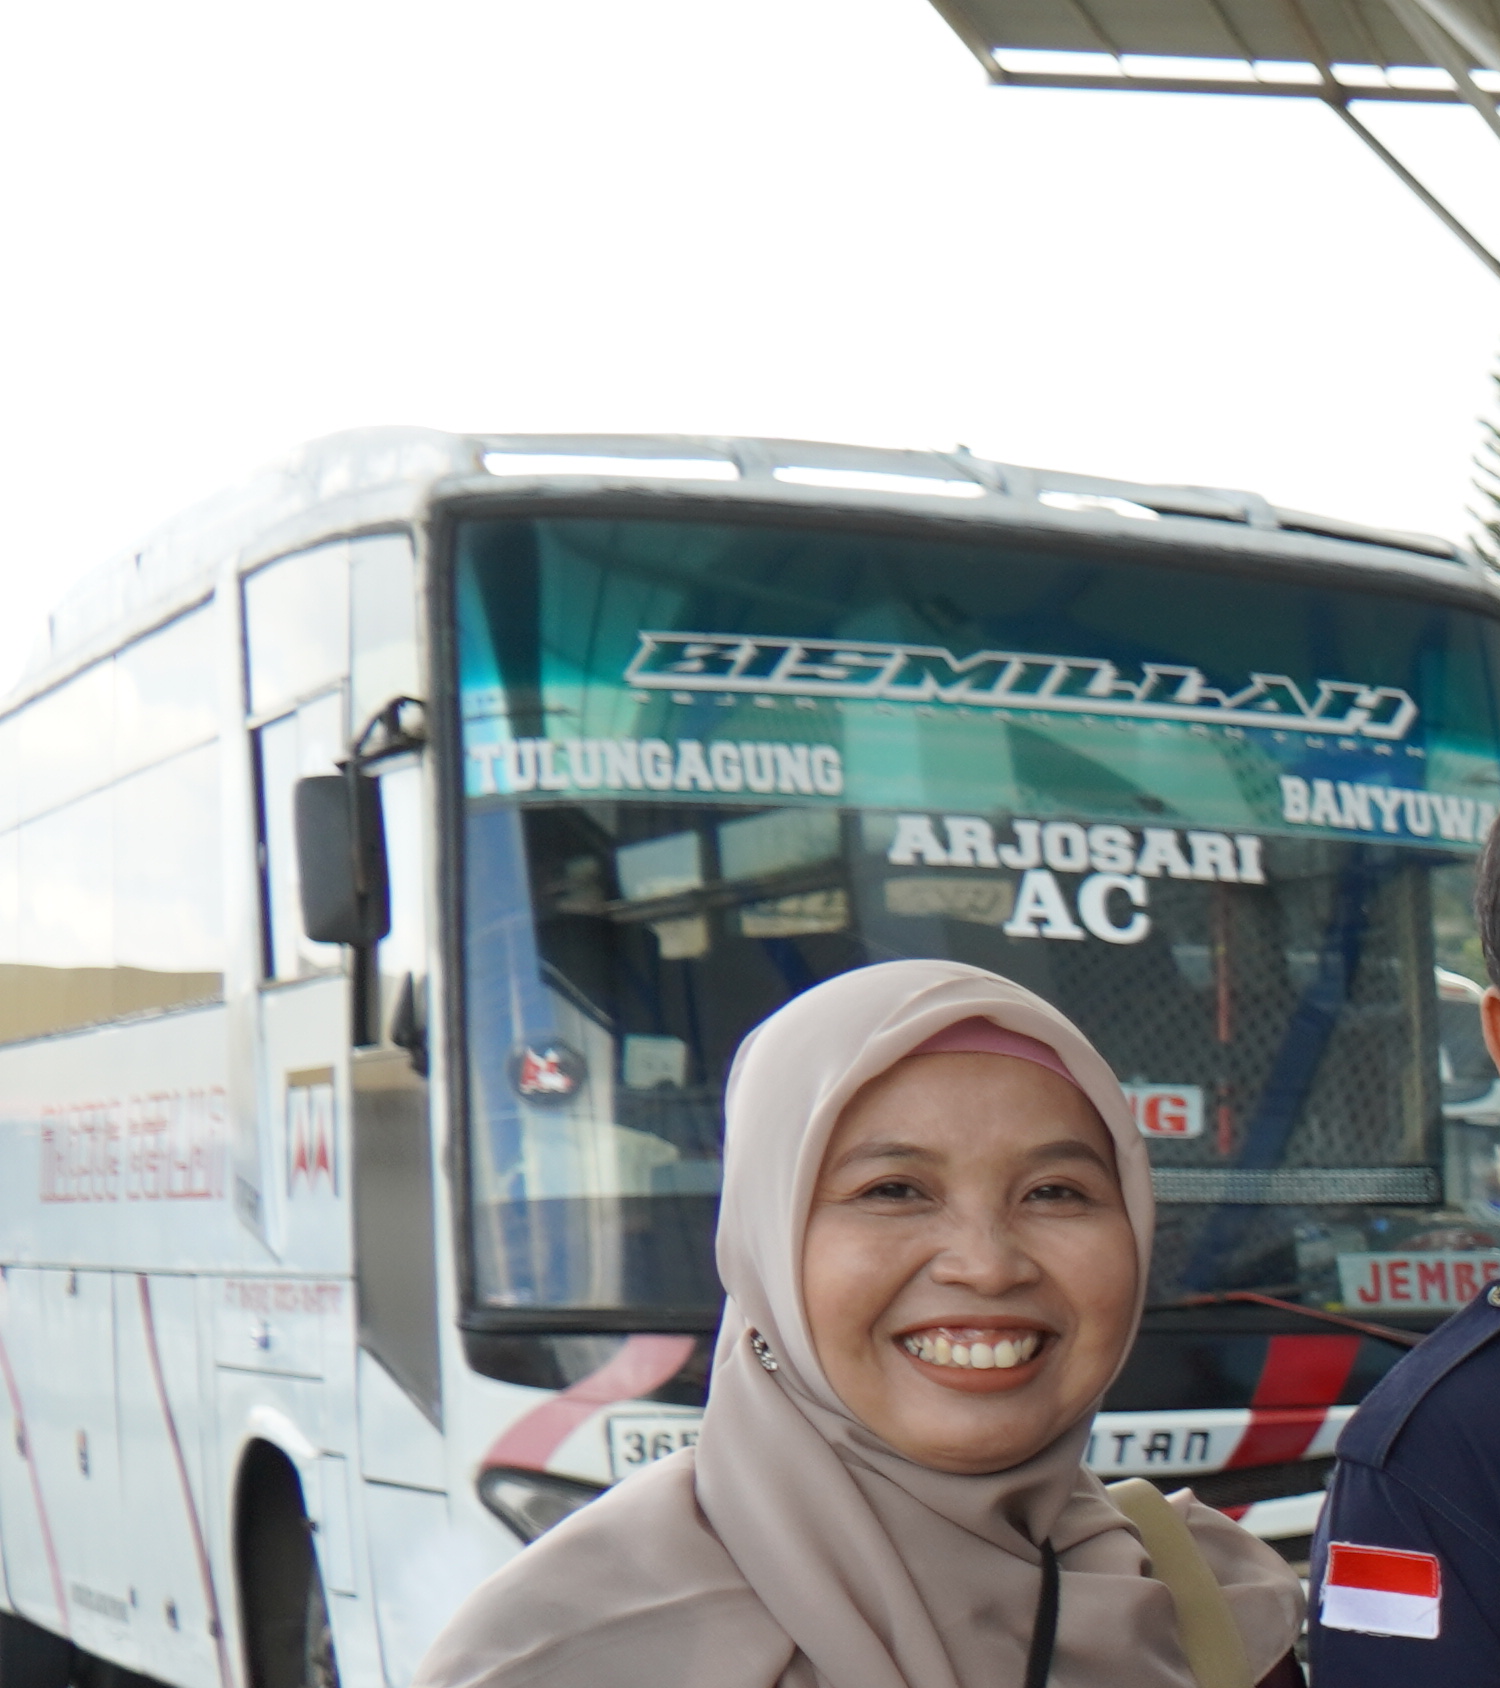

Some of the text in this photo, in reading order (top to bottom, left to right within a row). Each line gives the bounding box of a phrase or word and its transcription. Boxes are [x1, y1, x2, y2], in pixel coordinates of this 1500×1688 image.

[626, 630, 1421, 740] BISMILLAH
[466, 736, 846, 801] TULUNGAGUNG
[887, 815, 1265, 888] ARJOSARI
[1002, 870, 1154, 945] AC
